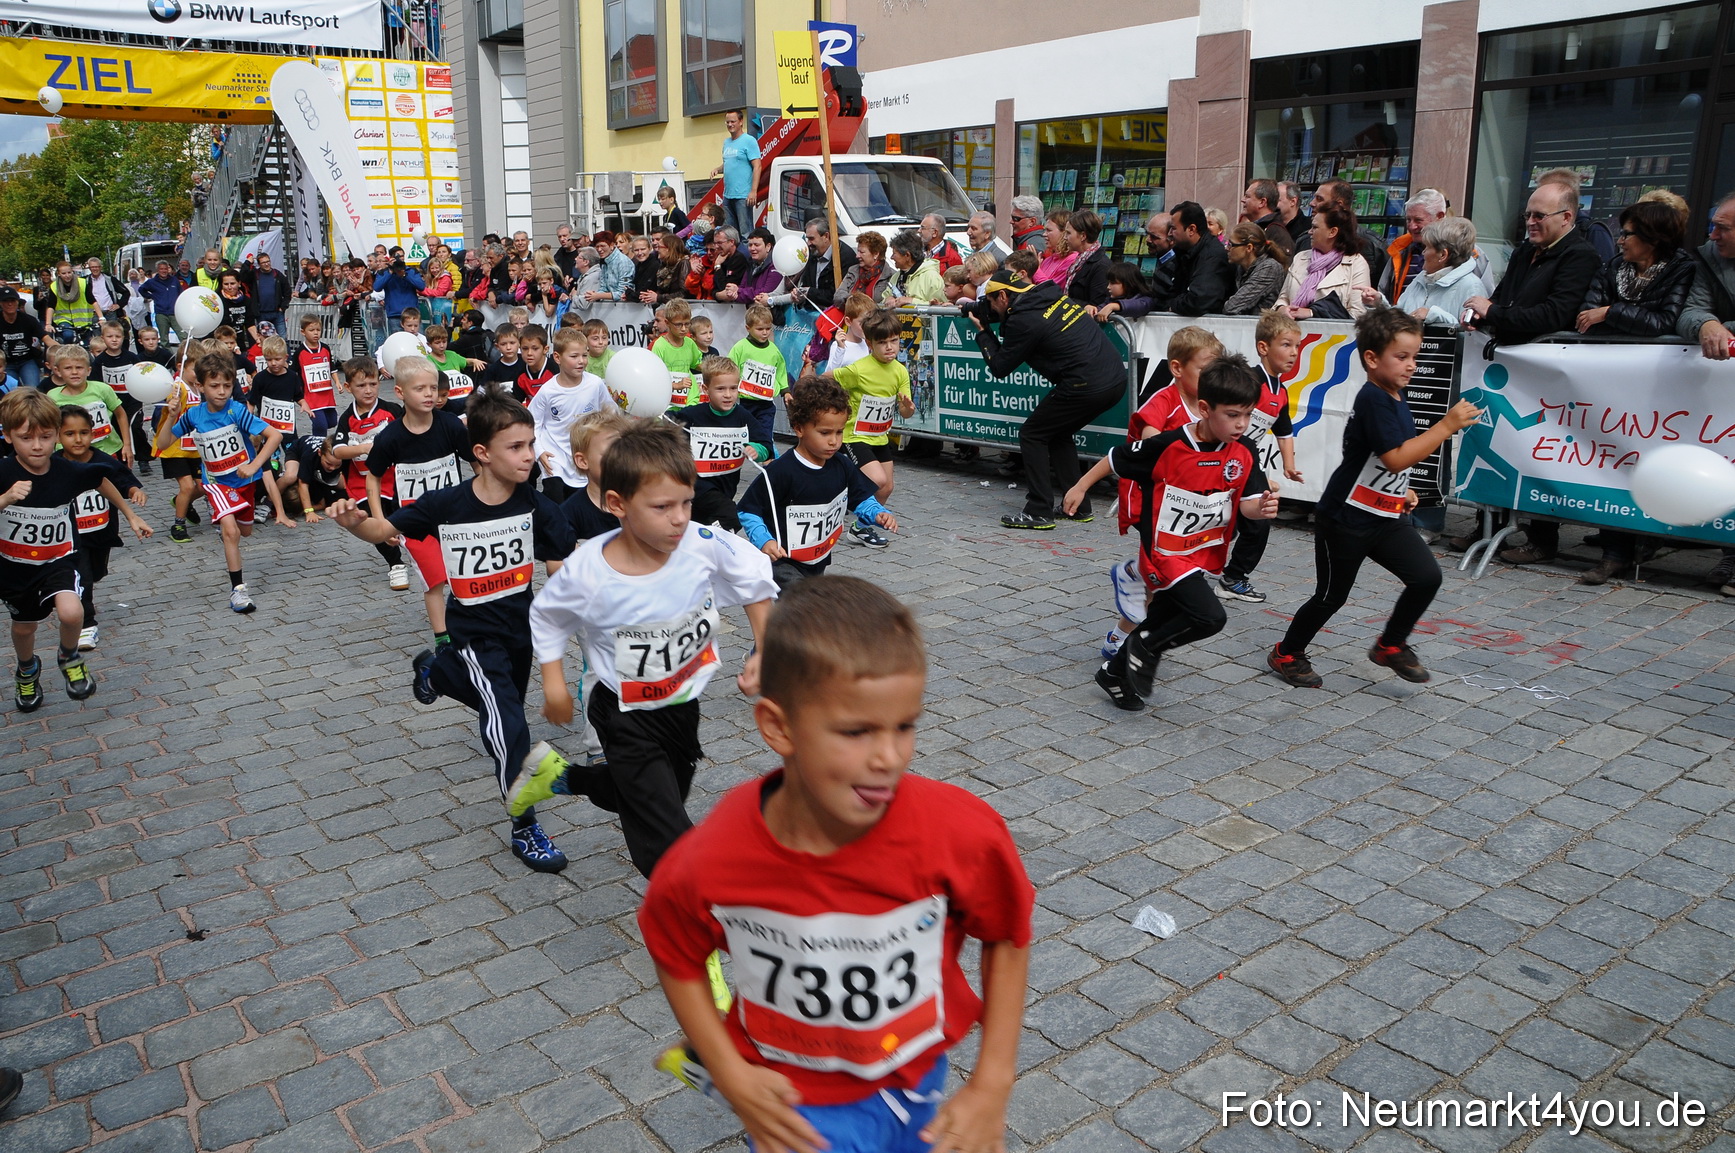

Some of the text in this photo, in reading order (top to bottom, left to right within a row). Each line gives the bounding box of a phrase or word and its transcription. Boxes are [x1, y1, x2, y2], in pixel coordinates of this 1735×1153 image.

[189, 2, 339, 30] BMW Laufsport
[778, 54, 815, 71] Jugend
[44, 54, 152, 94] ZIEL
[790, 71, 809, 85] lauf
[205, 83, 254, 92] Neumarkter
[883, 95, 901, 107] Markt
[902, 93, 910, 105] 15
[747, 367, 773, 387] 7150
[944, 362, 981, 382] Mehr
[863, 398, 879, 406] PARTL
[944, 385, 1040, 412] für Ihr Event!
[1407, 390, 1434, 400] Wasser
[264, 405, 291, 421] 7139
[945, 418, 965, 431] Miet
[966, 421, 974, 433] &
[975, 424, 1007, 438] Service
[1600, 407, 1690, 440] UNS
[199, 436, 240, 460] 7128
[697, 441, 742, 459] 7265
[420, 462, 448, 475] Neumarkt
[709, 463, 730, 471] Marc
[404, 471, 454, 498] 7174
[1166, 493, 1191, 507] PARTL
[1530, 488, 1637, 517] Service-Line:
[796, 507, 842, 546] 7152
[1170, 506, 1224, 535] 7271
[8, 520, 67, 545] 7390
[442, 525, 518, 542] PARTL Neumarkt
[451, 537, 525, 576] 7253
[469, 573, 515, 595] Gabriel
[616, 629, 658, 640] PARTL
[723, 914, 909, 955] PARTL Neumarkt
[747, 945, 917, 1022] 7383
